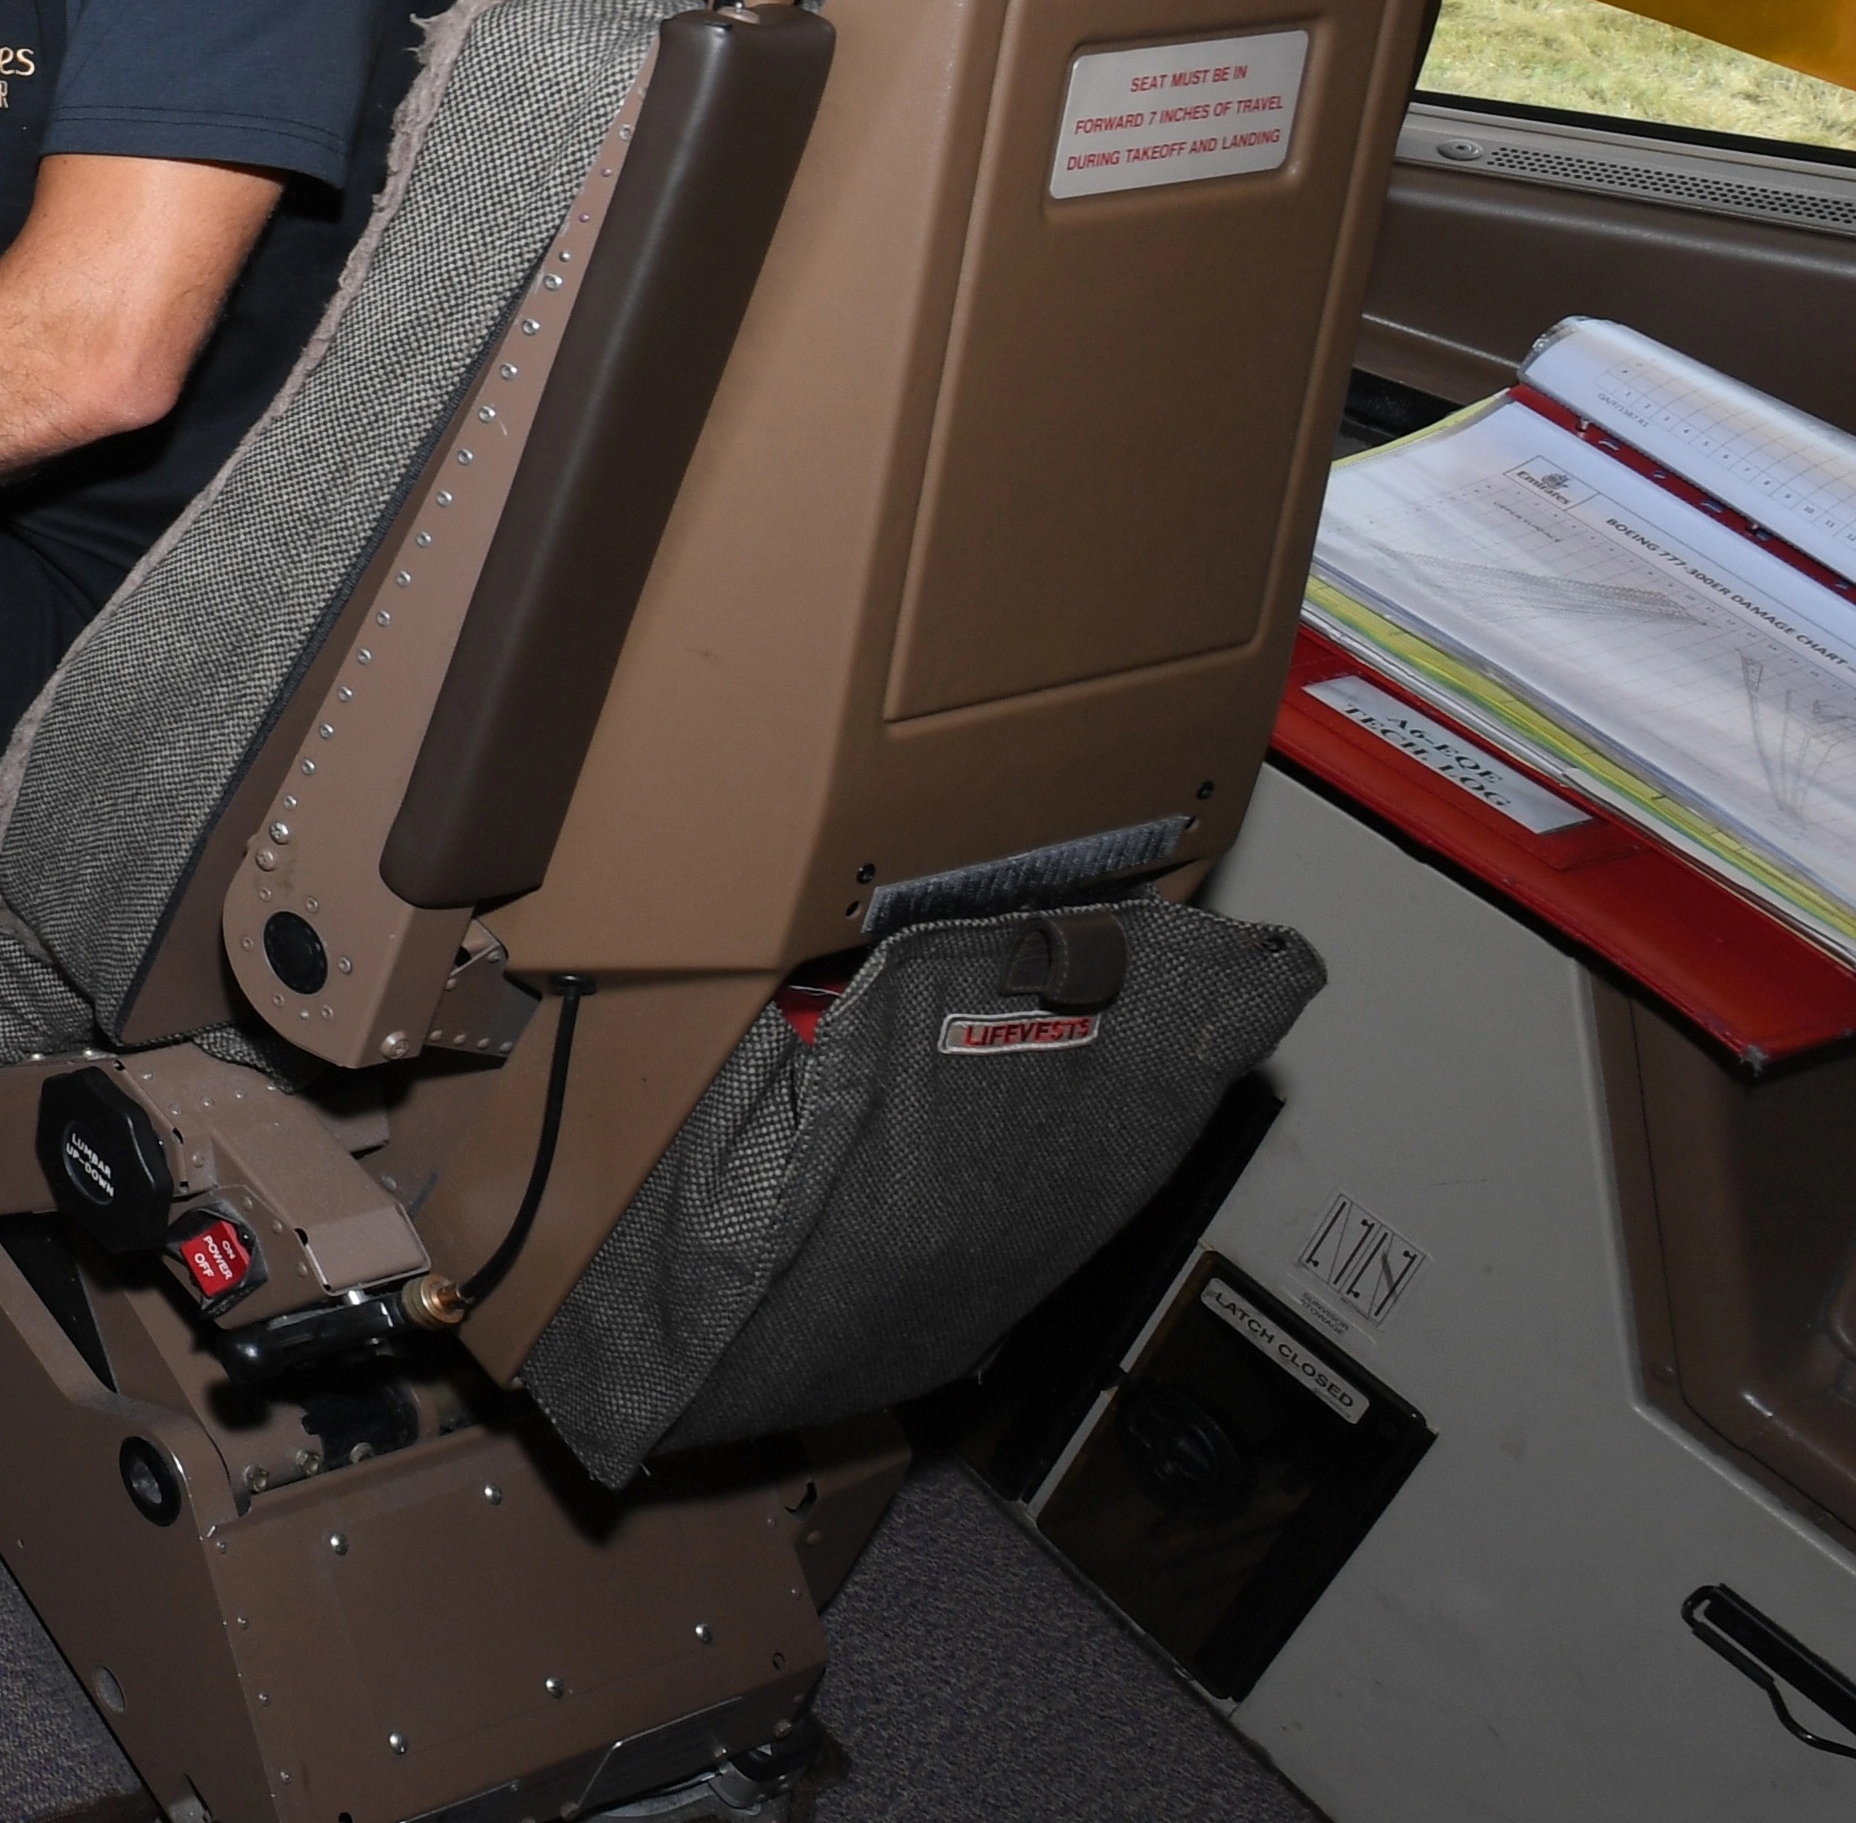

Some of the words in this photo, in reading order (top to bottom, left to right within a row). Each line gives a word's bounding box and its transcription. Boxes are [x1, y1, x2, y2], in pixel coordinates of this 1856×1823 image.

[1130, 75, 1167, 93] SEAT
[1170, 70, 1210, 87] MUST
[1212, 67, 1229, 83] BE
[1234, 65, 1248, 79] IN
[1075, 113, 1144, 135] FORWARD
[1149, 111, 1157, 125] 7
[1160, 105, 1209, 124] INCHES
[1214, 101, 1232, 117] OF
[1235, 96, 1283, 114] TRAVEL
[1066, 151, 1120, 171] DURING
[1125, 142, 1187, 163] TAKEOFF
[1189, 138, 1217, 154] AND
[1222, 129, 1281, 149] LANDING
[1516, 470, 1572, 506] Emirates
[1605, 518, 1661, 552] BOEING
[1659, 550, 1732, 597] 777-300ER
[1730, 593, 1798, 635] DAMAGE
[1795, 634, 1849, 667] CHART
[1344, 702, 1428, 761] TECH.
[1439, 764, 1512, 806] LOG
[1388, 717, 1503, 784] A6-EQE
[963, 1016, 1091, 1048] LIFEVESTS
[65, 1142, 115, 1198] UP-DOWN
[70, 1132, 113, 1180] LUMBAR
[194, 1253, 215, 1279] OFF
[203, 1234, 234, 1281] POWER
[221, 1240, 236, 1260] ON
[1216, 1293, 1275, 1344] LATCH
[1278, 1344, 1354, 1407] CLOSED
